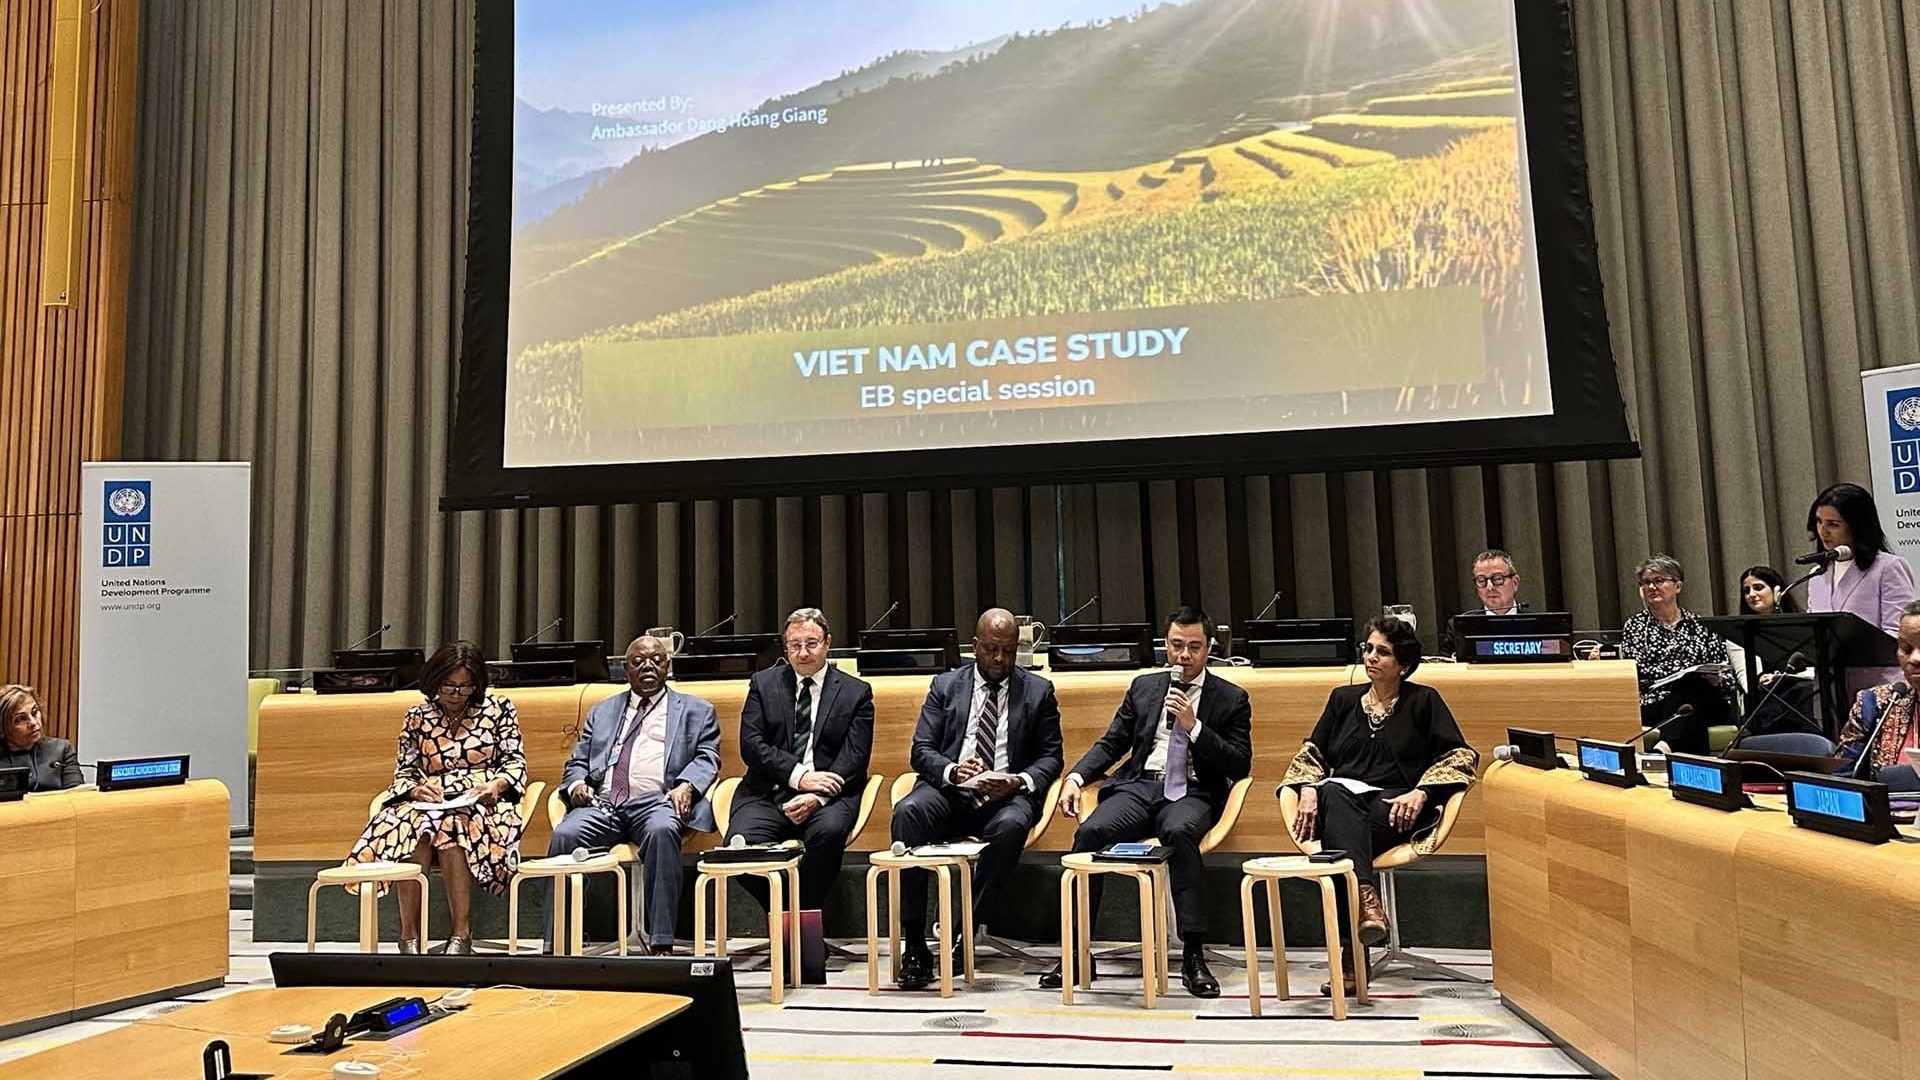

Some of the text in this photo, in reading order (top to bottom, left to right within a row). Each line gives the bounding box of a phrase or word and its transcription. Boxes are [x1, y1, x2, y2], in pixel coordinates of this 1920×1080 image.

[592, 95, 694, 116] Presented By:
[591, 120, 682, 140] Ambassador
[783, 107, 828, 124] Giang
[793, 327, 1190, 377] VIET NAM CASE STUDY
[860, 375, 1096, 409] EB special session
[101, 578, 166, 587] United Nations
[101, 587, 211, 598] Development Programme
[100, 602, 161, 612] www.undp.org
[1493, 641, 1542, 655] SECRETARY
[1817, 790, 1841, 817] JAPAN
